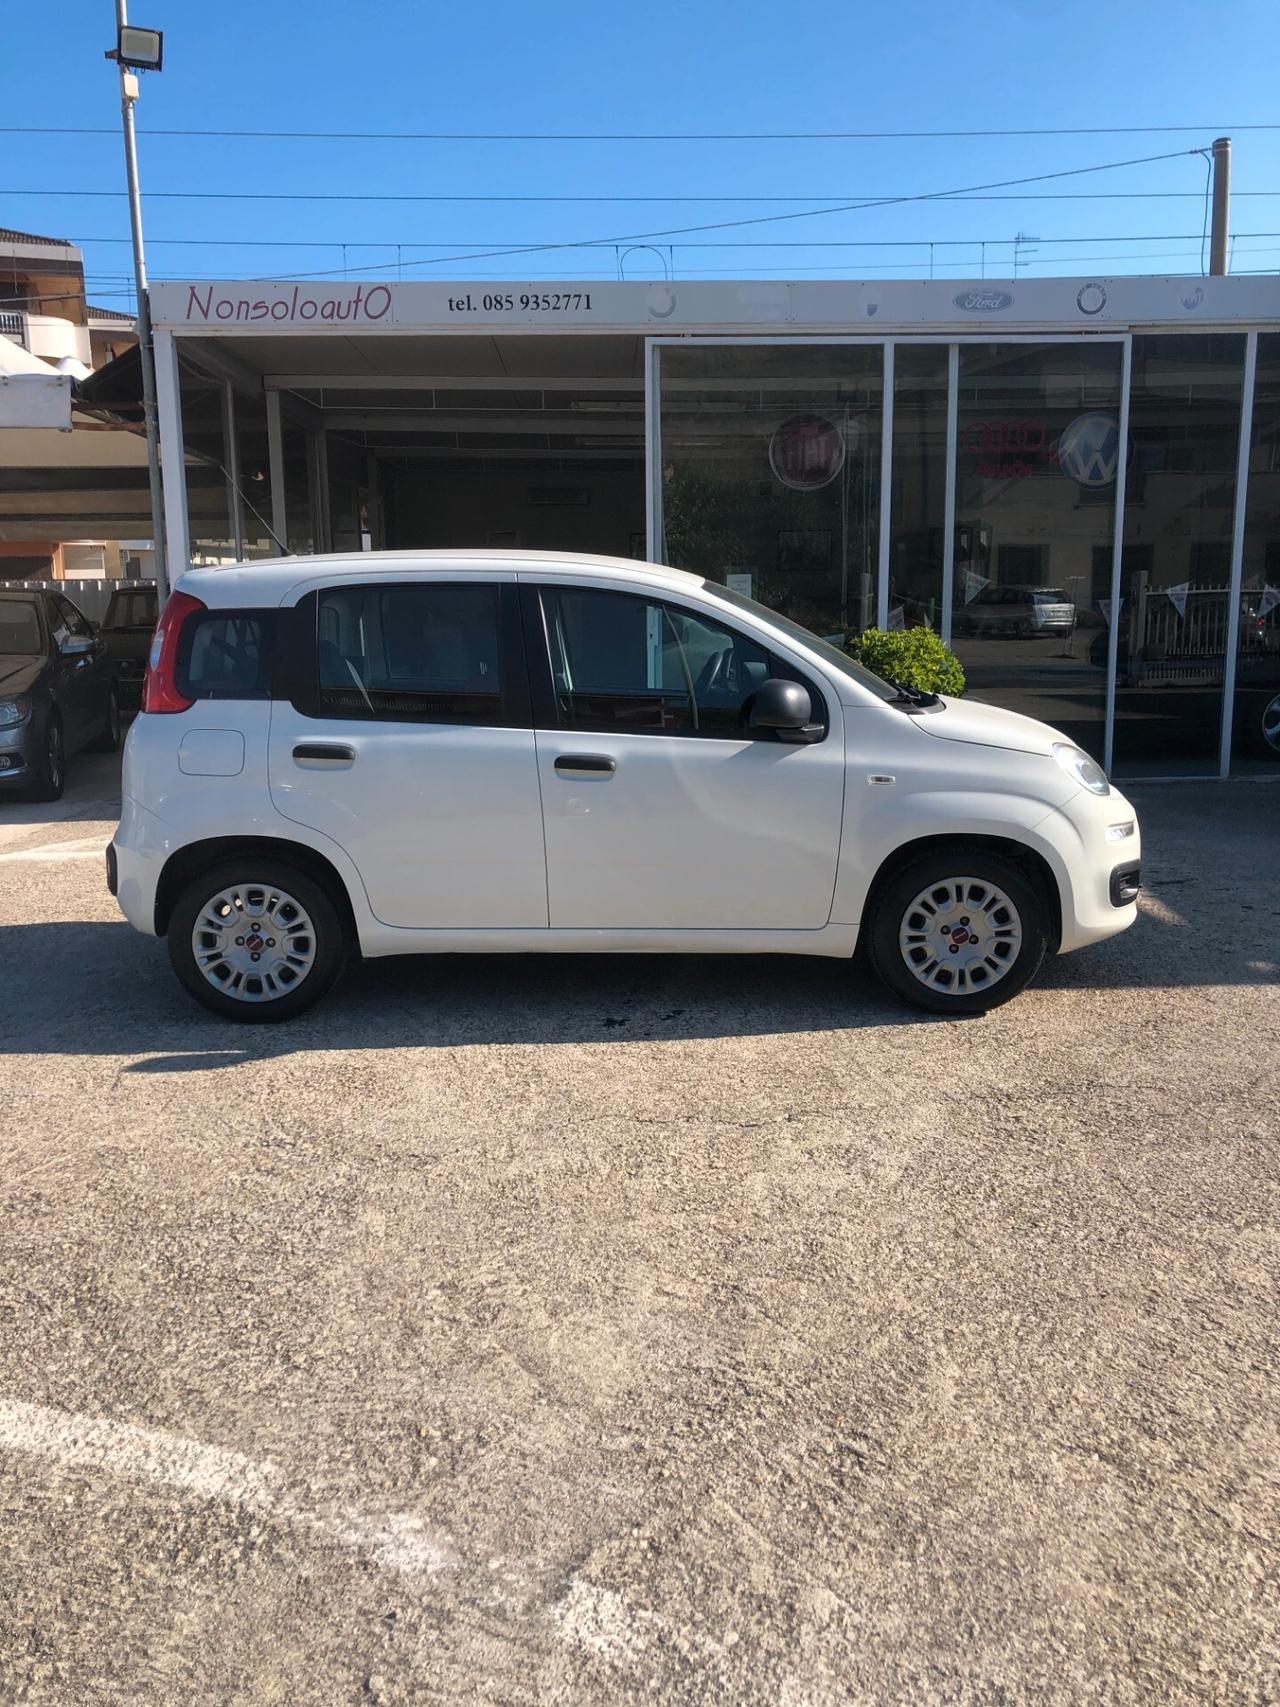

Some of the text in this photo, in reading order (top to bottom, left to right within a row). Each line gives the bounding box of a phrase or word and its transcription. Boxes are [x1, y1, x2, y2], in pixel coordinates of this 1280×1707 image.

[448, 294, 592, 311] tel. 085 9352771
[965, 291, 1002, 308] Ford
